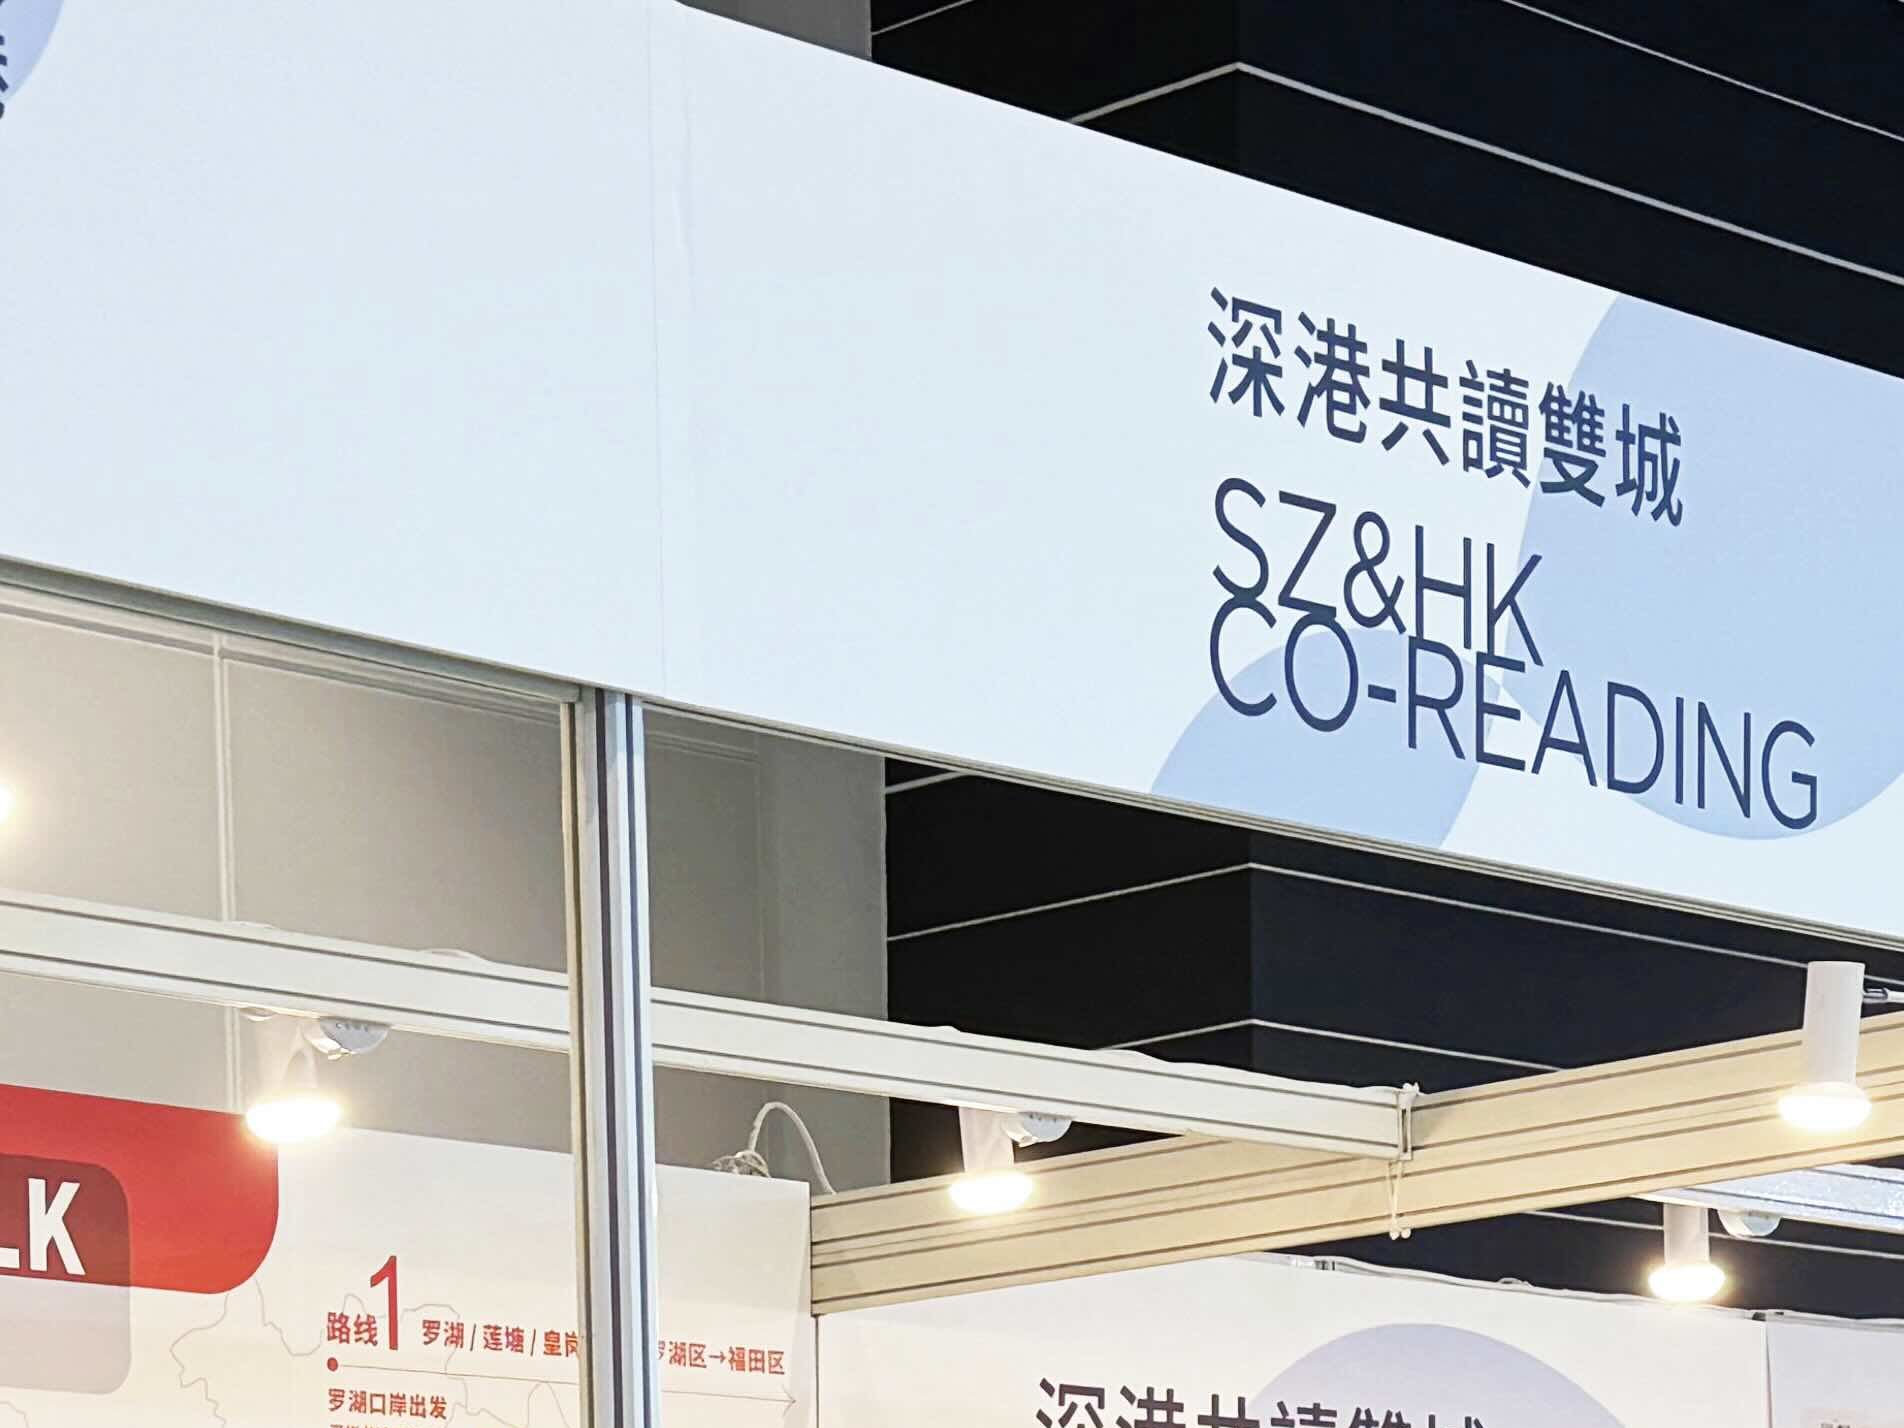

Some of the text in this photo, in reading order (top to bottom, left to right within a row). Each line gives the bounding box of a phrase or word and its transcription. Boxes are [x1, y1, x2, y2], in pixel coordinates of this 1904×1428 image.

[1207, 287, 1684, 528] 深港共讀雙城
[1213, 478, 1543, 666] SZ&HK
[1210, 595, 1818, 830] CO-READING
[327, 1312, 378, 1346] 路线
[370, 1255, 398, 1350] 1
[328, 1388, 447, 1420] 罗湖口岸出发
